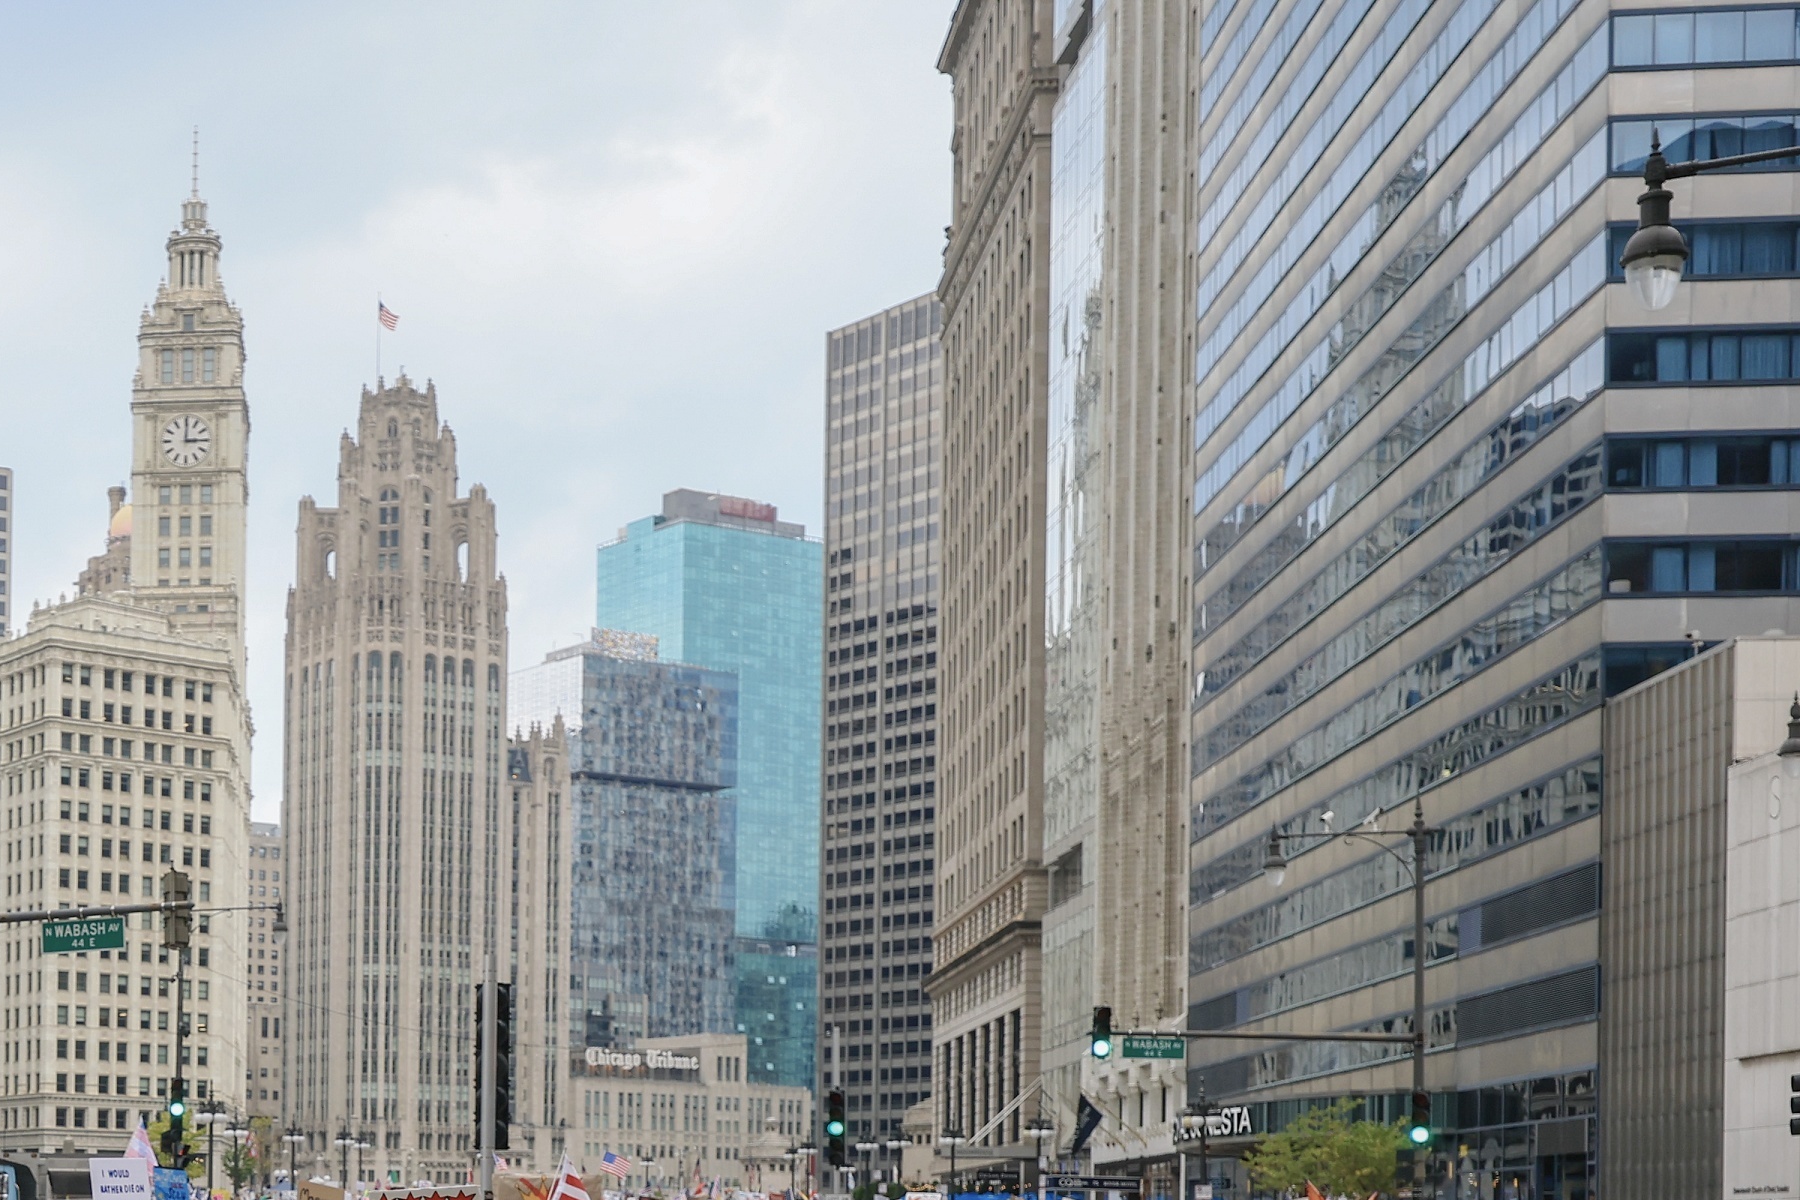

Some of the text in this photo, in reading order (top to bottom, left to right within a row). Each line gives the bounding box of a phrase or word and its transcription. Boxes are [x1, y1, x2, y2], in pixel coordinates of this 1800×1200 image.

[45, 922, 120, 937] N WABASH AV
[71, 938, 96, 947] 44 E
[1132, 1040, 1172, 1049] WABASH
[109, 1169, 130, 1179] WOULD
[100, 1184, 145, 1194] RATHER DIE ON
